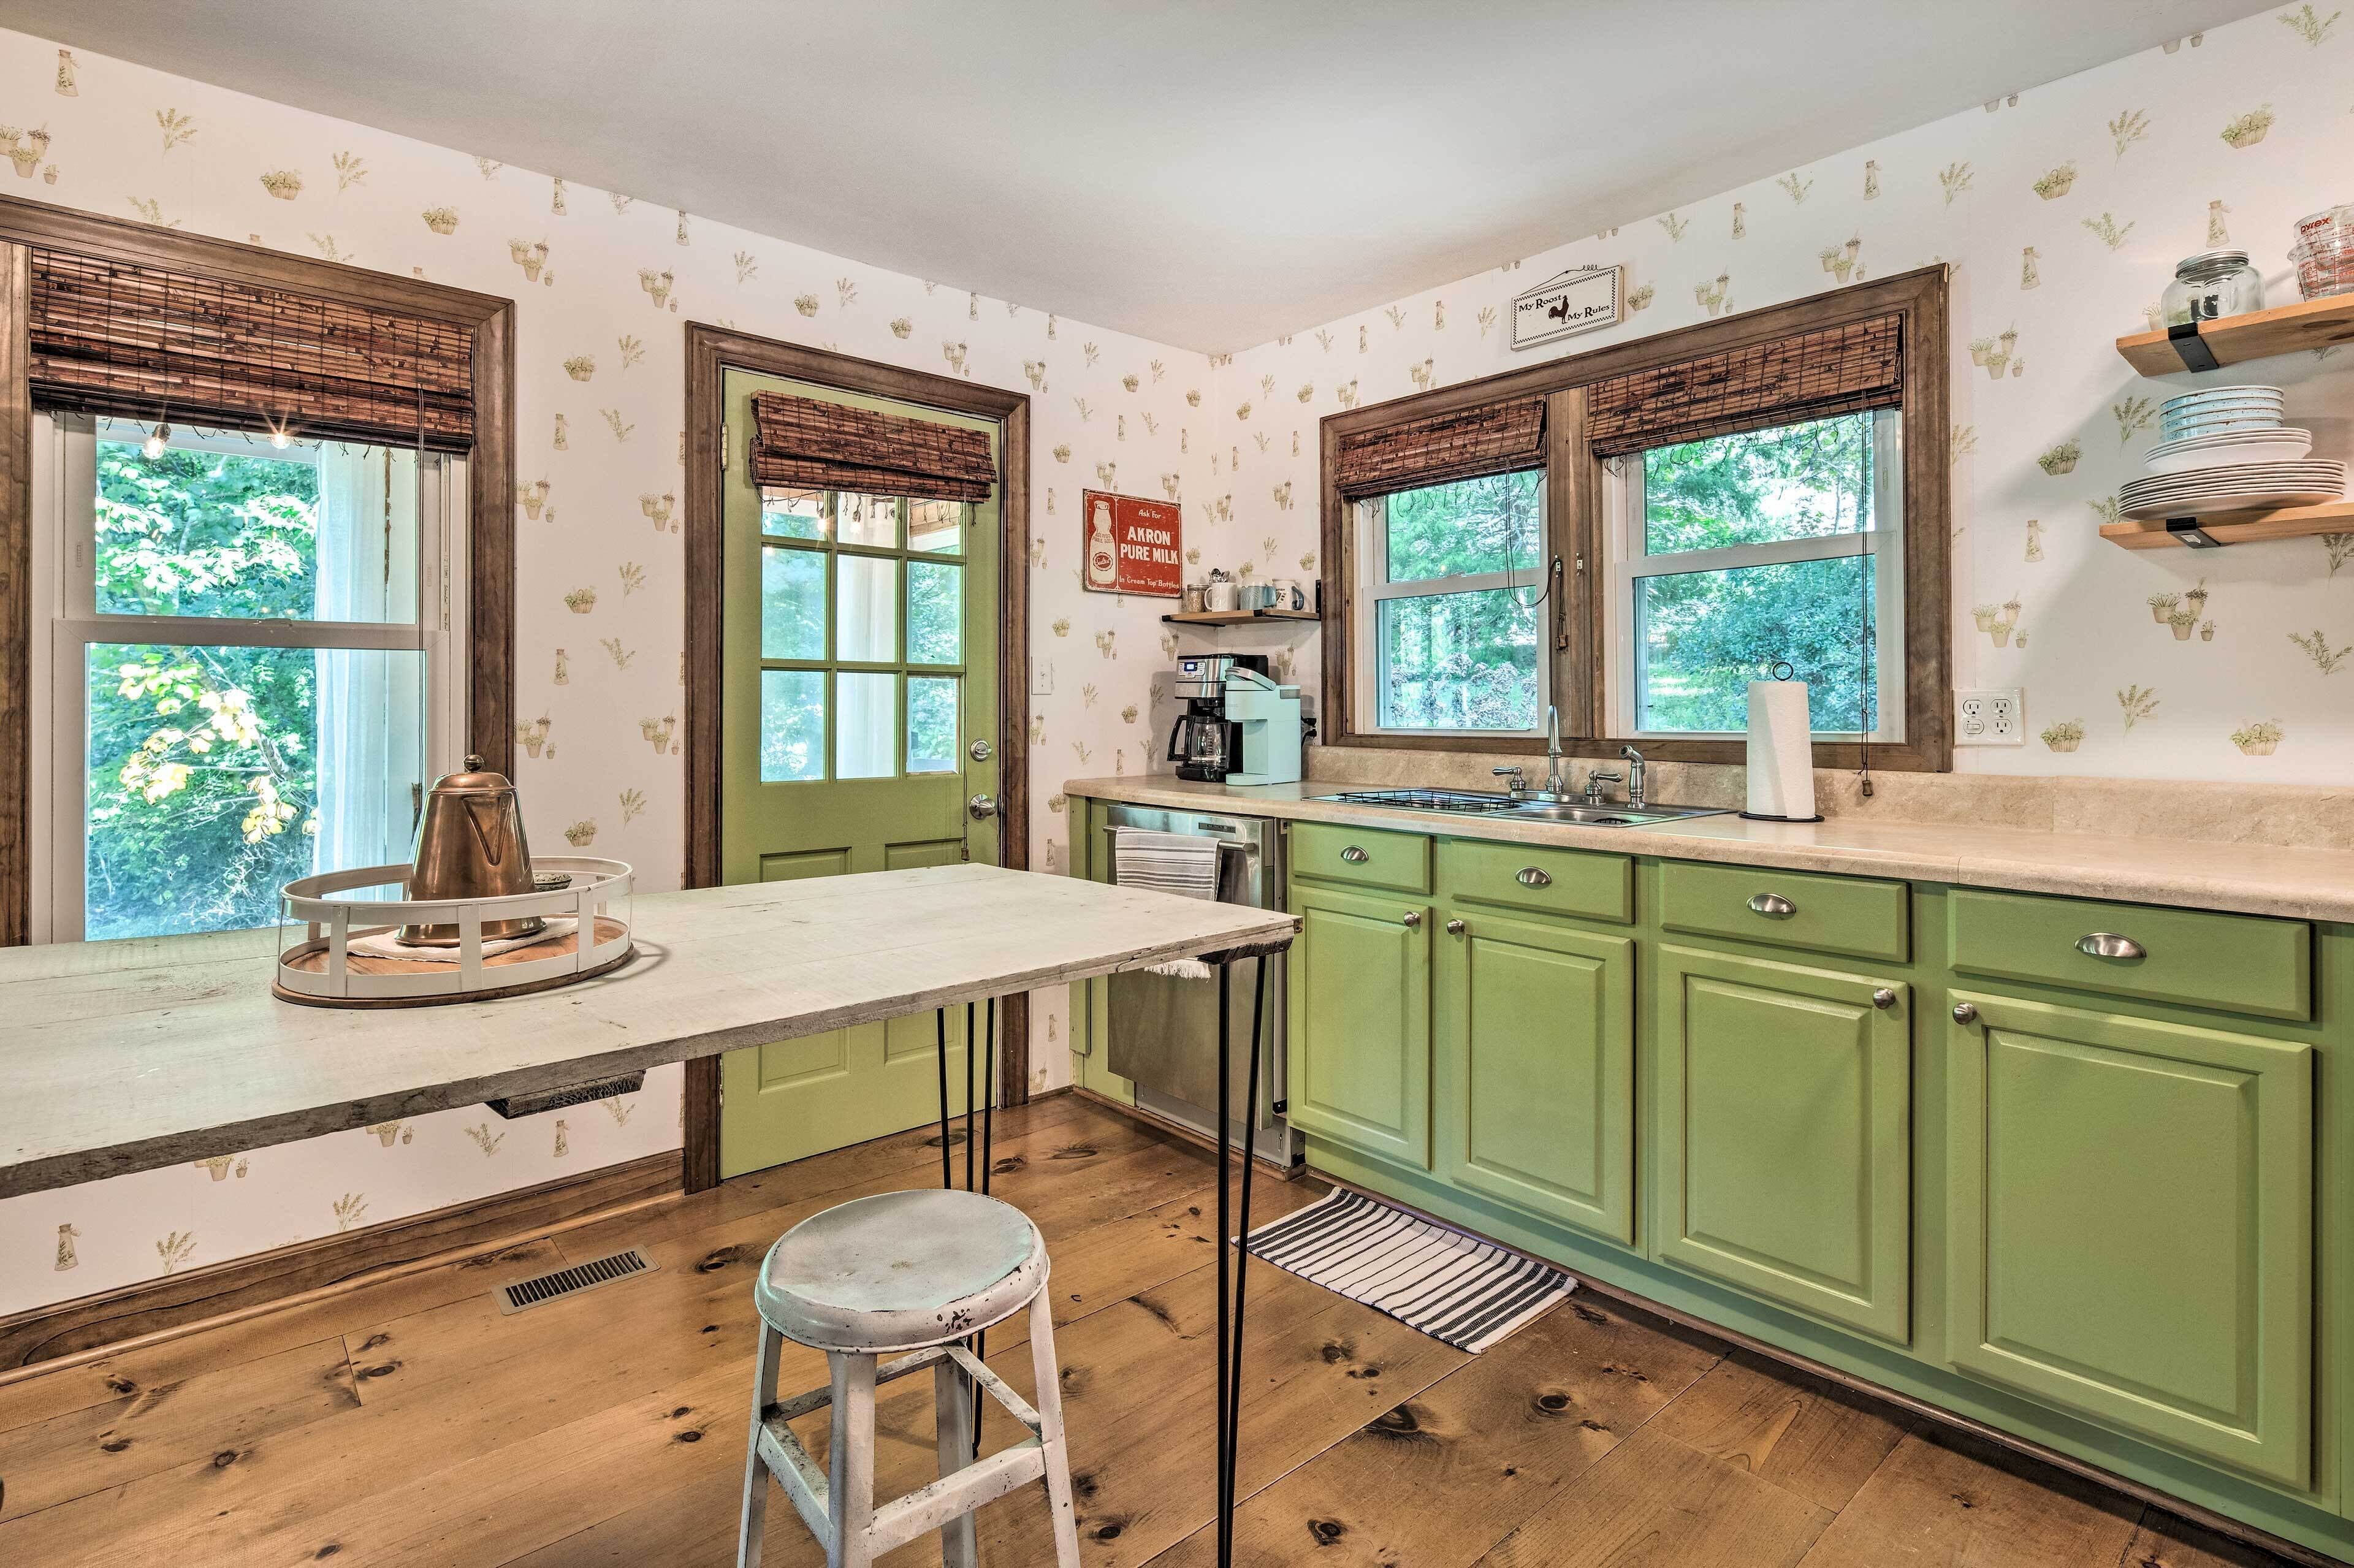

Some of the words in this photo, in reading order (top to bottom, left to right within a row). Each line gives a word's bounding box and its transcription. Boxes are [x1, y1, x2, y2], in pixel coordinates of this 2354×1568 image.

[2300, 217, 2330, 234] pyrex
[1518, 303, 1534, 313] My
[1535, 294, 1561, 310] Roost
[1567, 312, 1583, 322] My
[1584, 304, 1610, 318] Rules
[1152, 511, 1161, 519] For
[1127, 526, 1171, 546] AKRON
[1120, 543, 1150, 561] PURE
[1152, 547, 1179, 565] MILK
[1127, 576, 1145, 585] Cream
[1147, 578, 1156, 588] Top
[1158, 579, 1179, 589] Bottles
